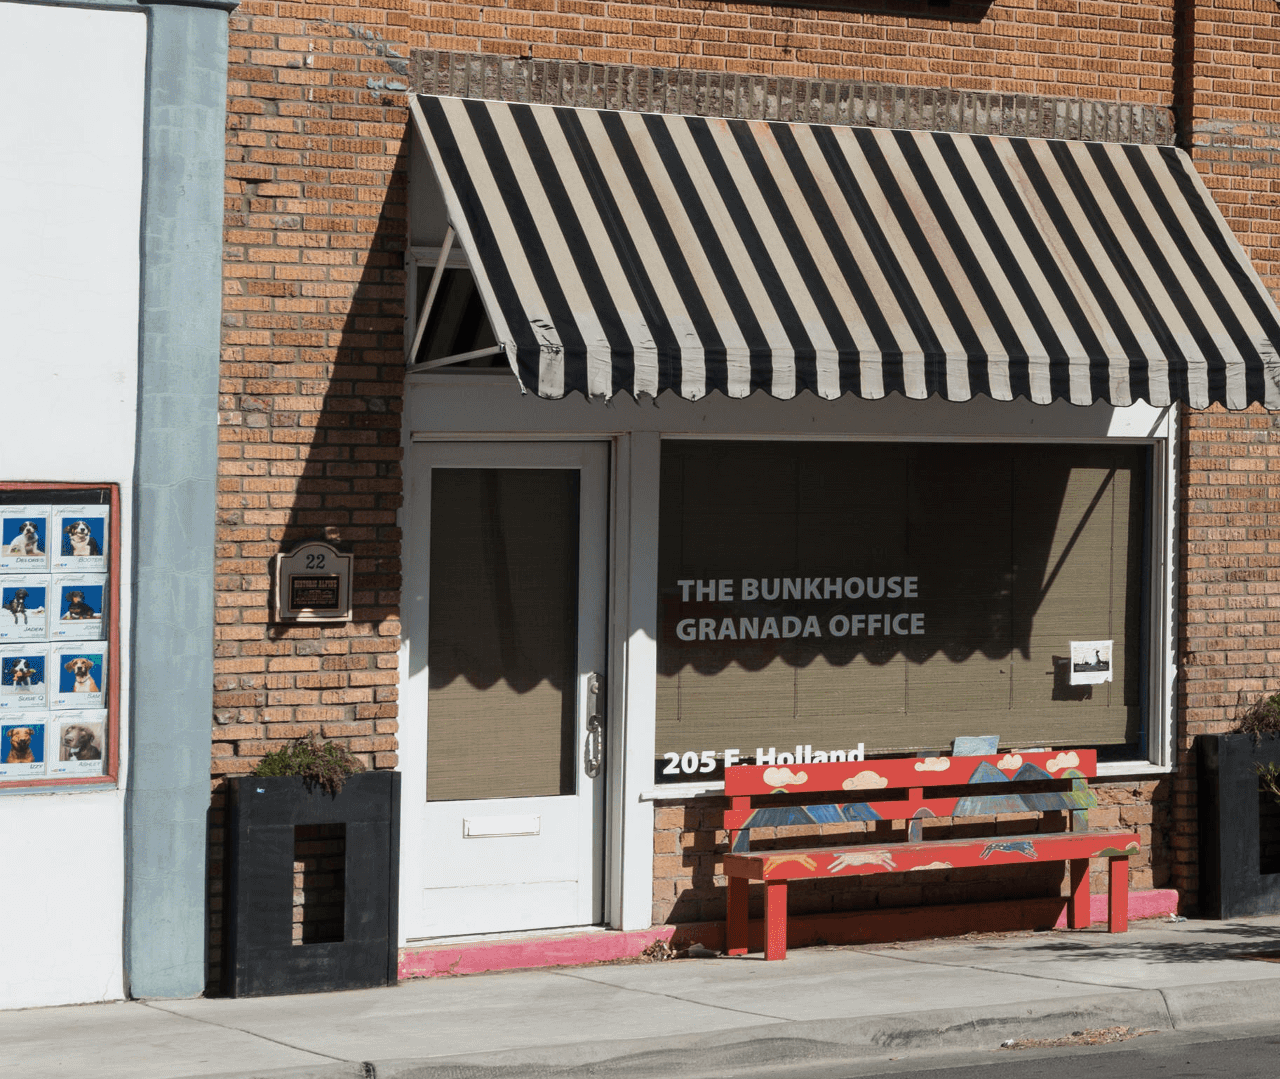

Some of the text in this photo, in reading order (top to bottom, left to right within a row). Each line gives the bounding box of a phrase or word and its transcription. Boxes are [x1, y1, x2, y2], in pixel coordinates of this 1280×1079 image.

[305, 553, 326, 570] 22
[677, 576, 919, 602] THE BUNKHOUSE
[676, 613, 925, 641] GRANADA OFFICE
[663, 750, 717, 775] 205
[756, 743, 865, 766] Holland
